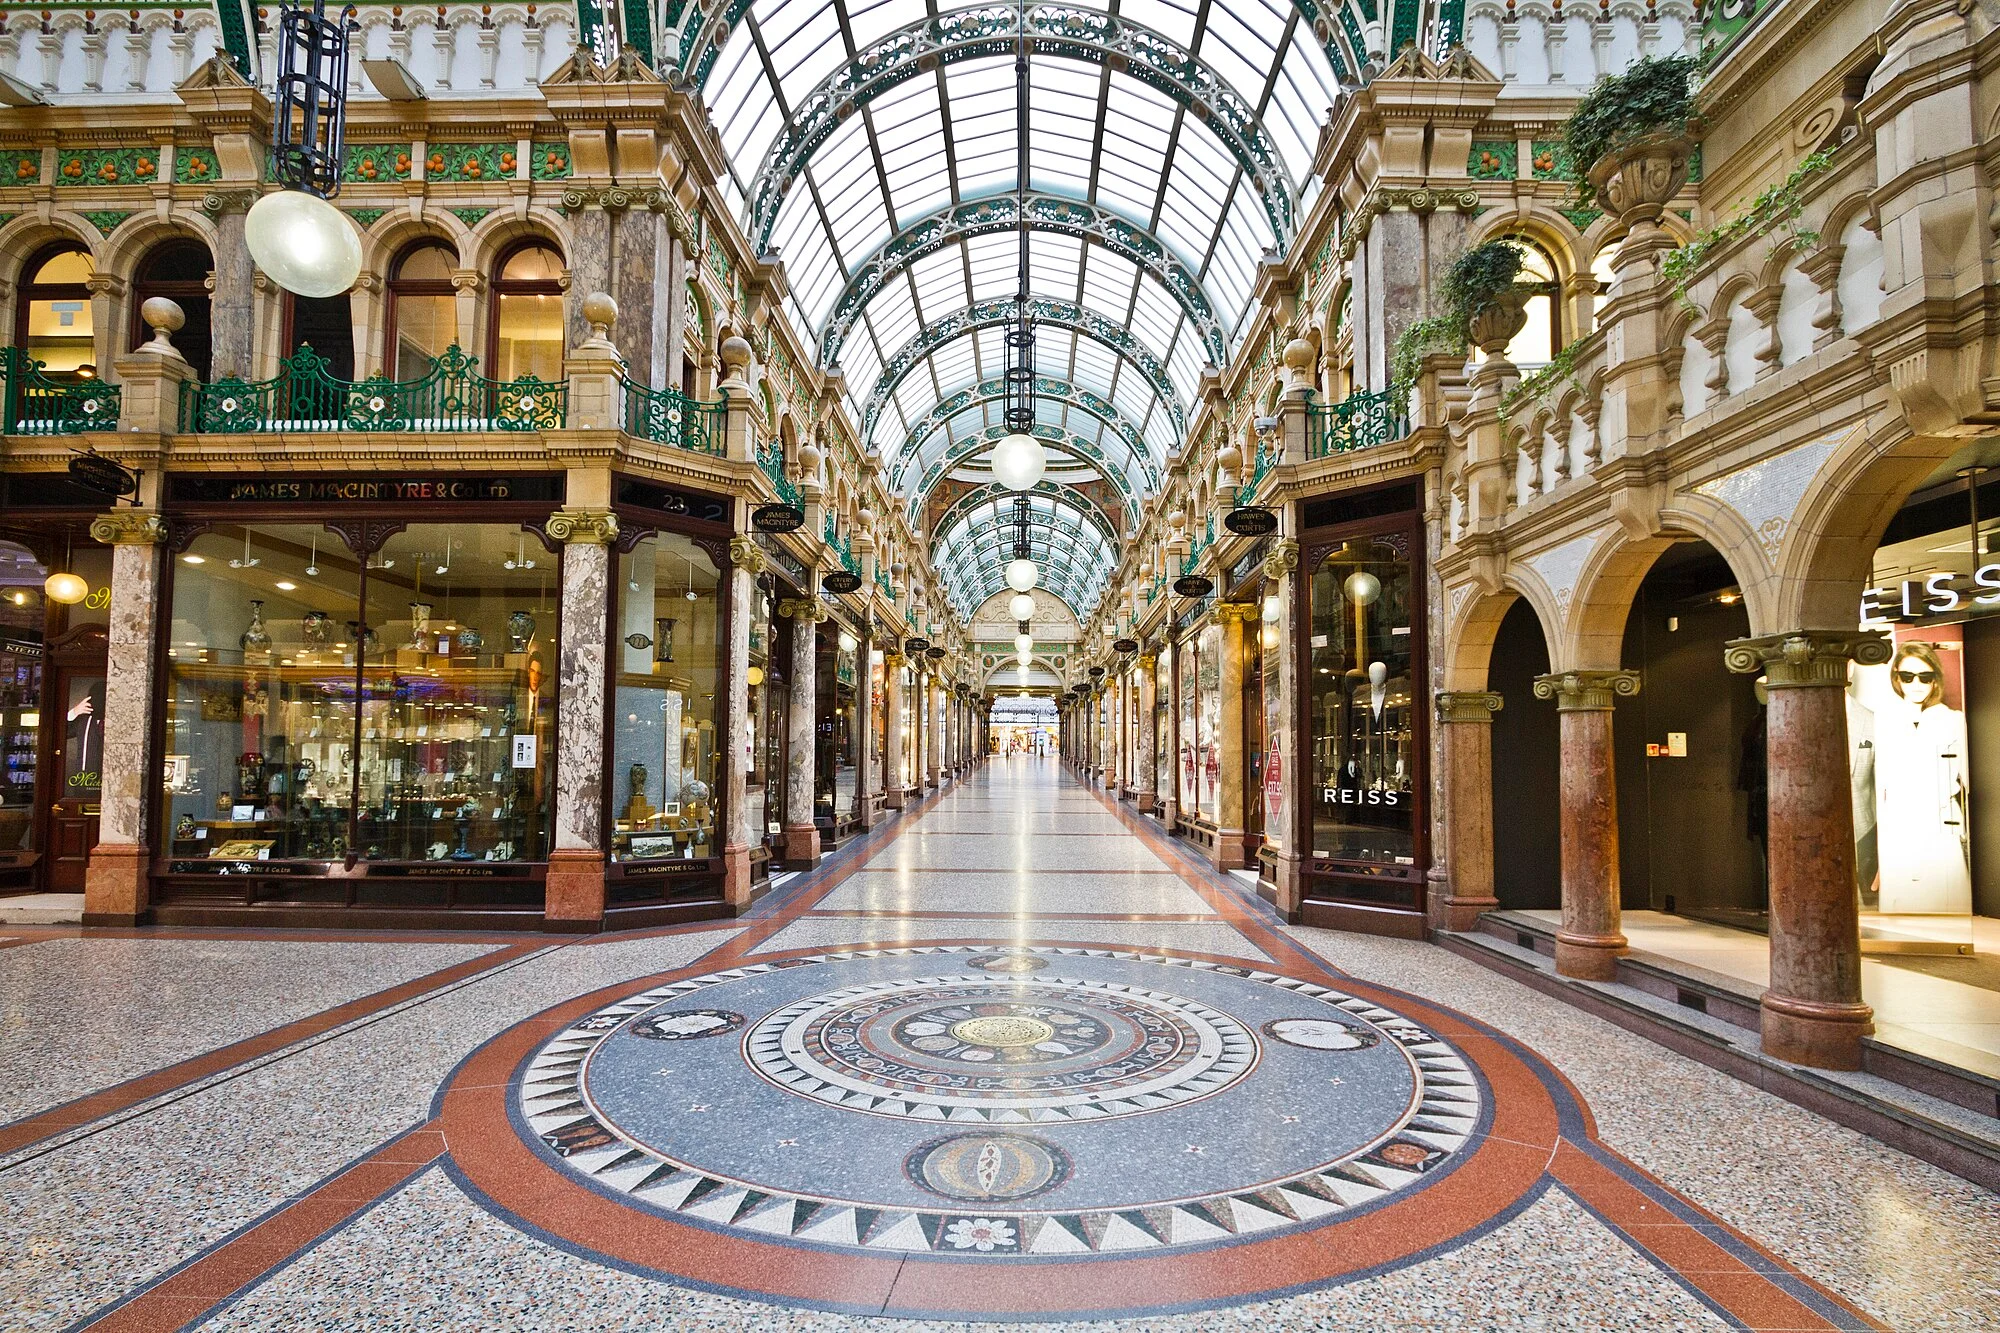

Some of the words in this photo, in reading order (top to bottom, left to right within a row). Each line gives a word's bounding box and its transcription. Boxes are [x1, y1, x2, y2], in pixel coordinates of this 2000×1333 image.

[231, 482, 300, 499] JAMES
[309, 482, 432, 498] MACINTYRE
[435, 483, 447, 498] &
[756, 519, 799, 527] MACINTYRE
[1235, 524, 1266, 532] CURTIS
[1324, 788, 1398, 805] REISS
[648, 865, 681, 873] MACINTYRE
